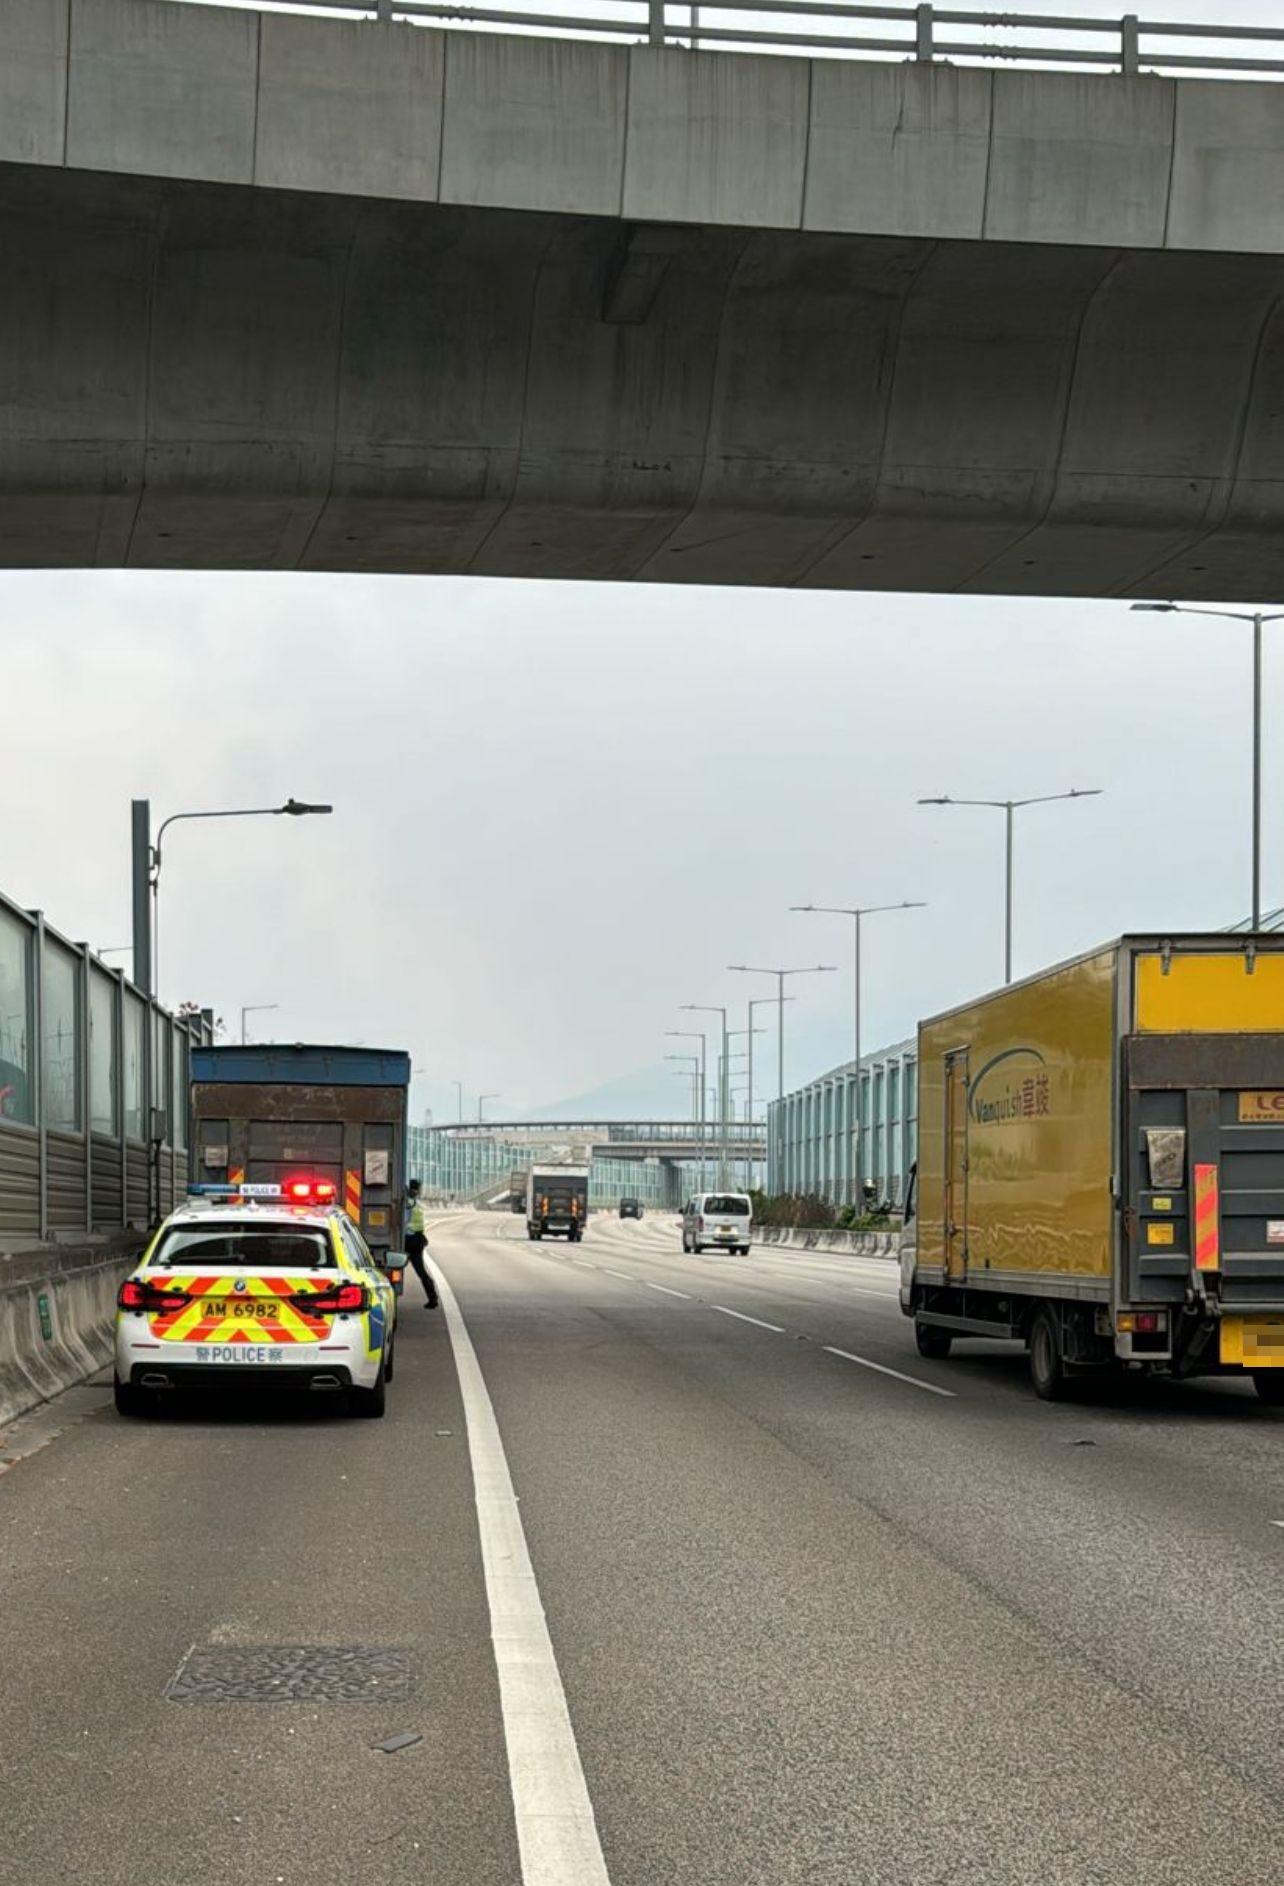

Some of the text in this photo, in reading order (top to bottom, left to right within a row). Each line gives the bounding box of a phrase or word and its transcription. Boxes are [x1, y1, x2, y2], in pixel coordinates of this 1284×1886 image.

[976, 1085, 1021, 1127] Vanquish
[205, 1303, 277, 1318] AM 6982
[211, 1347, 266, 1361] POLICE
